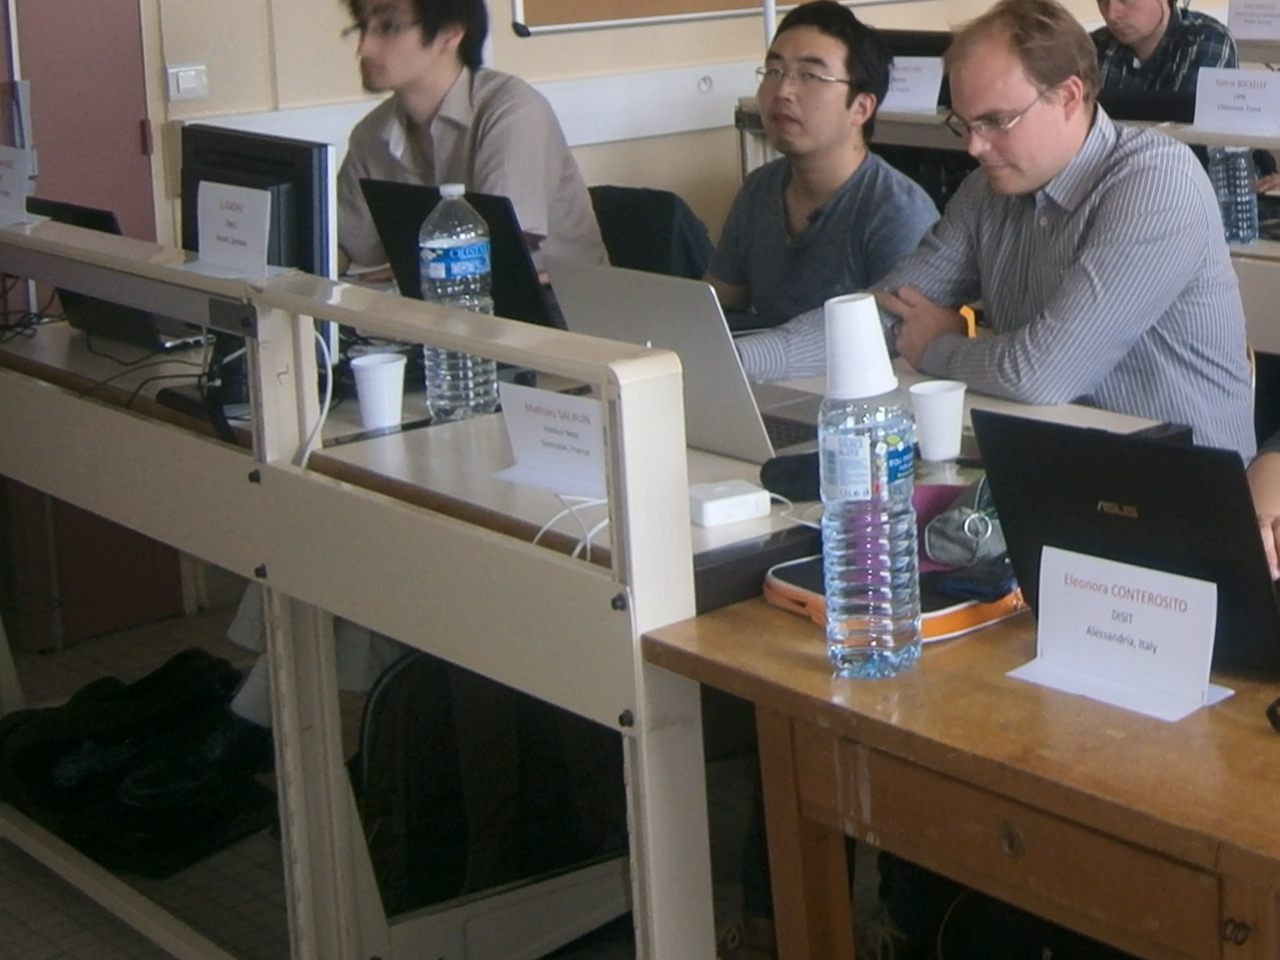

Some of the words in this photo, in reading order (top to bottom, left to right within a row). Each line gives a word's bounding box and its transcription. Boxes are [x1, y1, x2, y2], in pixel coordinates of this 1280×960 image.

[1063, 572, 1109, 595] Eleonora
[1111, 583, 1188, 613] CONTEROSITO
[1085, 626, 1137, 650] Alessandria,
[1138, 639, 1158, 655] Italy
